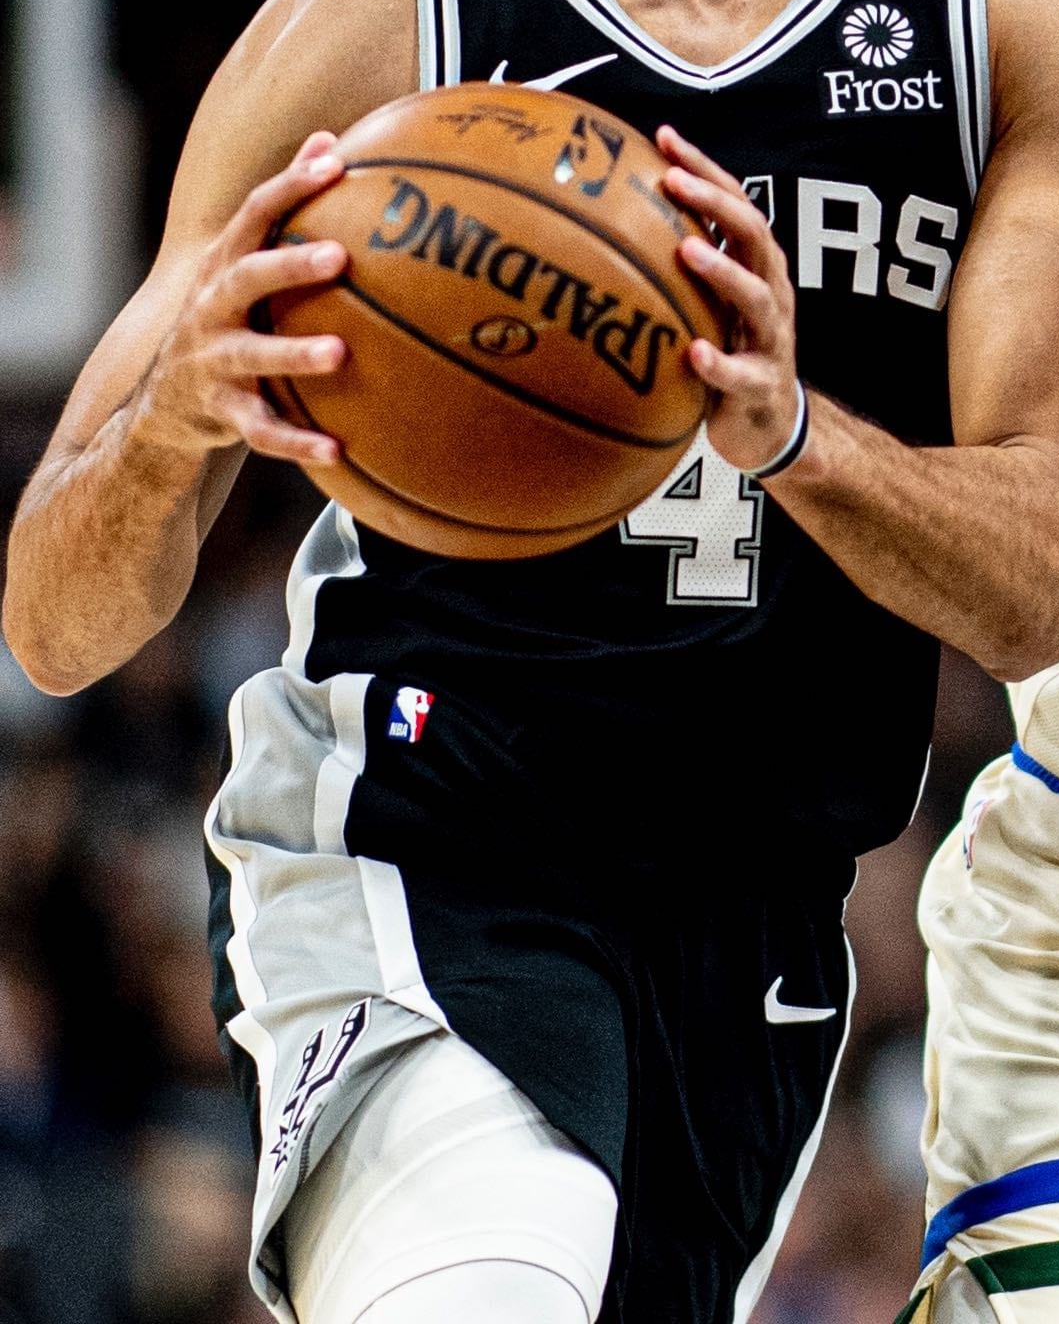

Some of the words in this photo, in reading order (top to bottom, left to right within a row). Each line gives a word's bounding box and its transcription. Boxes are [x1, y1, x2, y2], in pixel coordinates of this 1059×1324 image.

[823, 69, 943, 114] Frost
[367, 175, 678, 396] SPALDING
[738, 174, 958, 312] RS
[619, 420, 764, 607] 4
